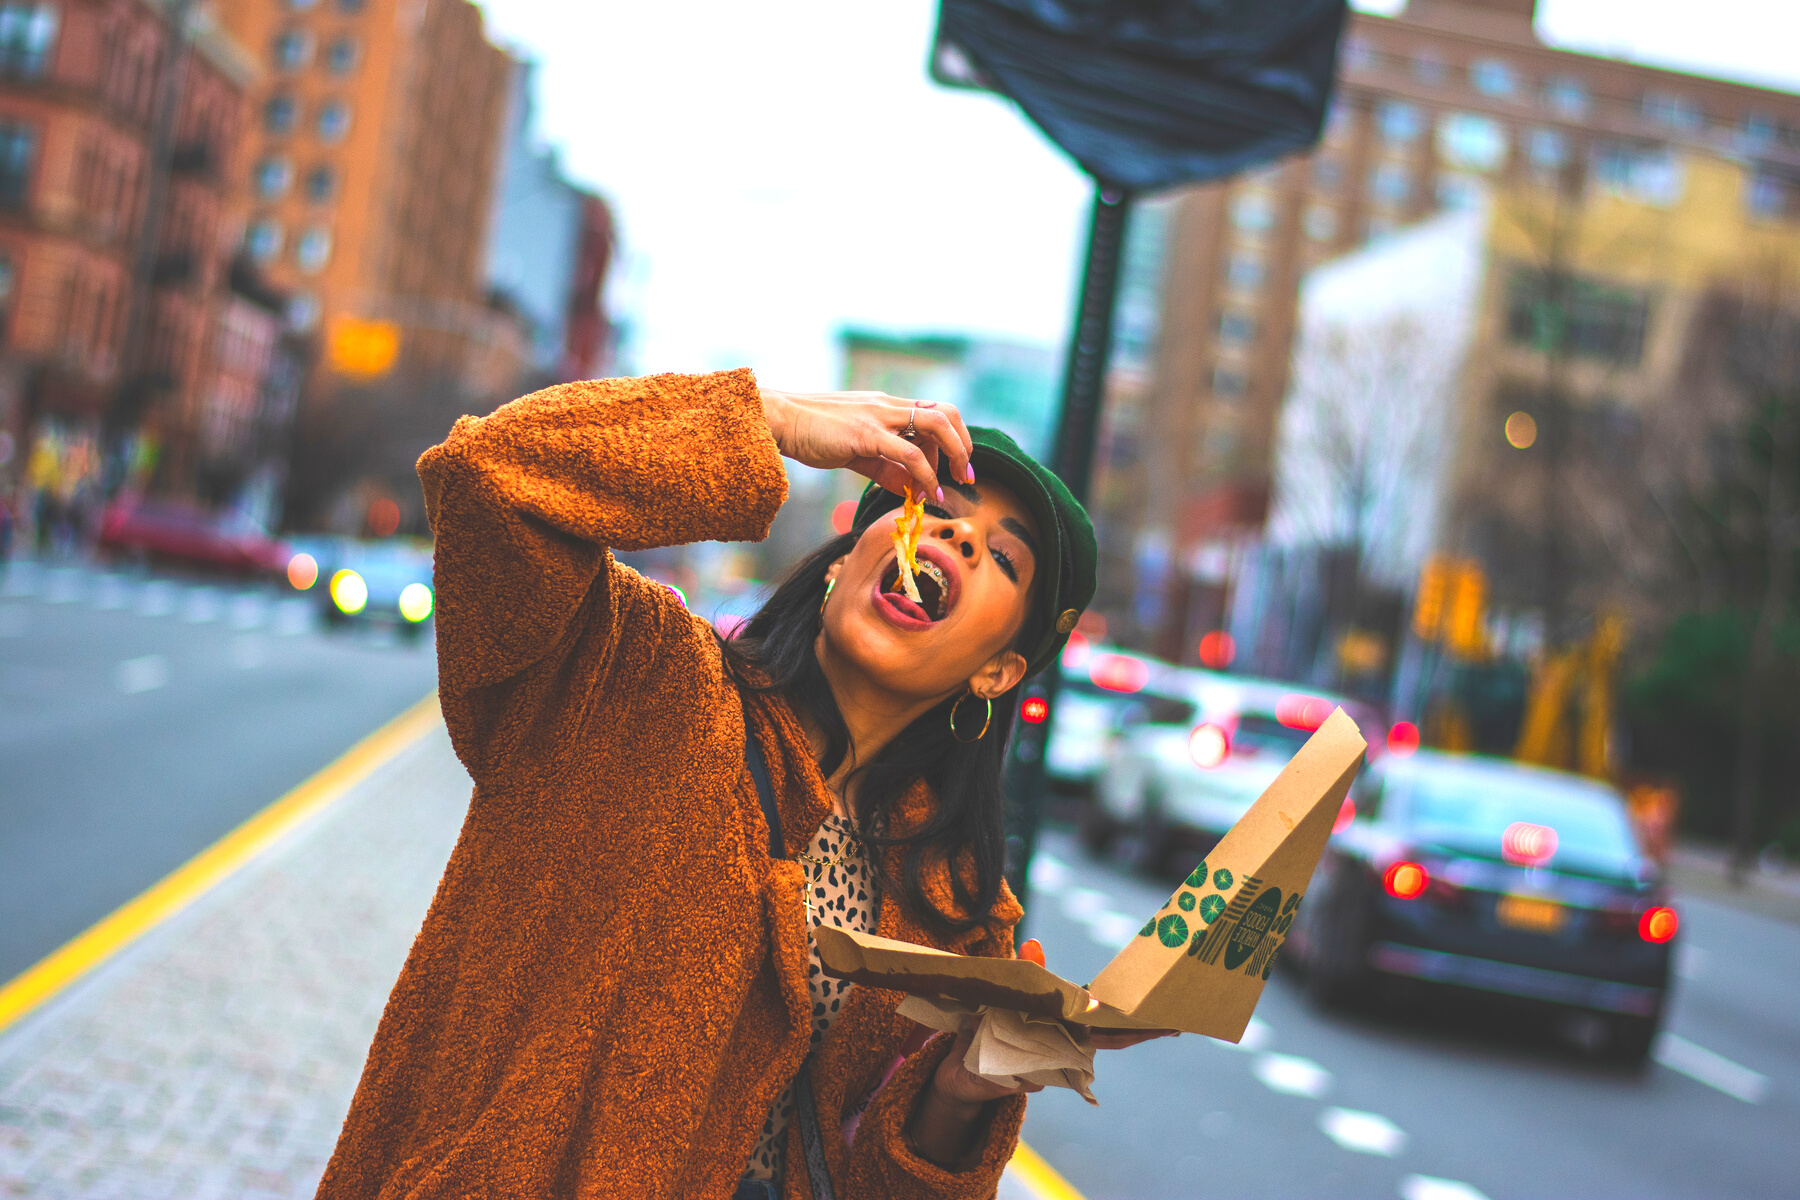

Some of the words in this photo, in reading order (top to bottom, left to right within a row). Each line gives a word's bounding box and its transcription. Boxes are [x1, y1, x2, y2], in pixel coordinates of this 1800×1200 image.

[1256, 903, 1274, 913] MARKET
[1242, 910, 1270, 932] FOODS
[1232, 926, 1261, 948] WHOLE
